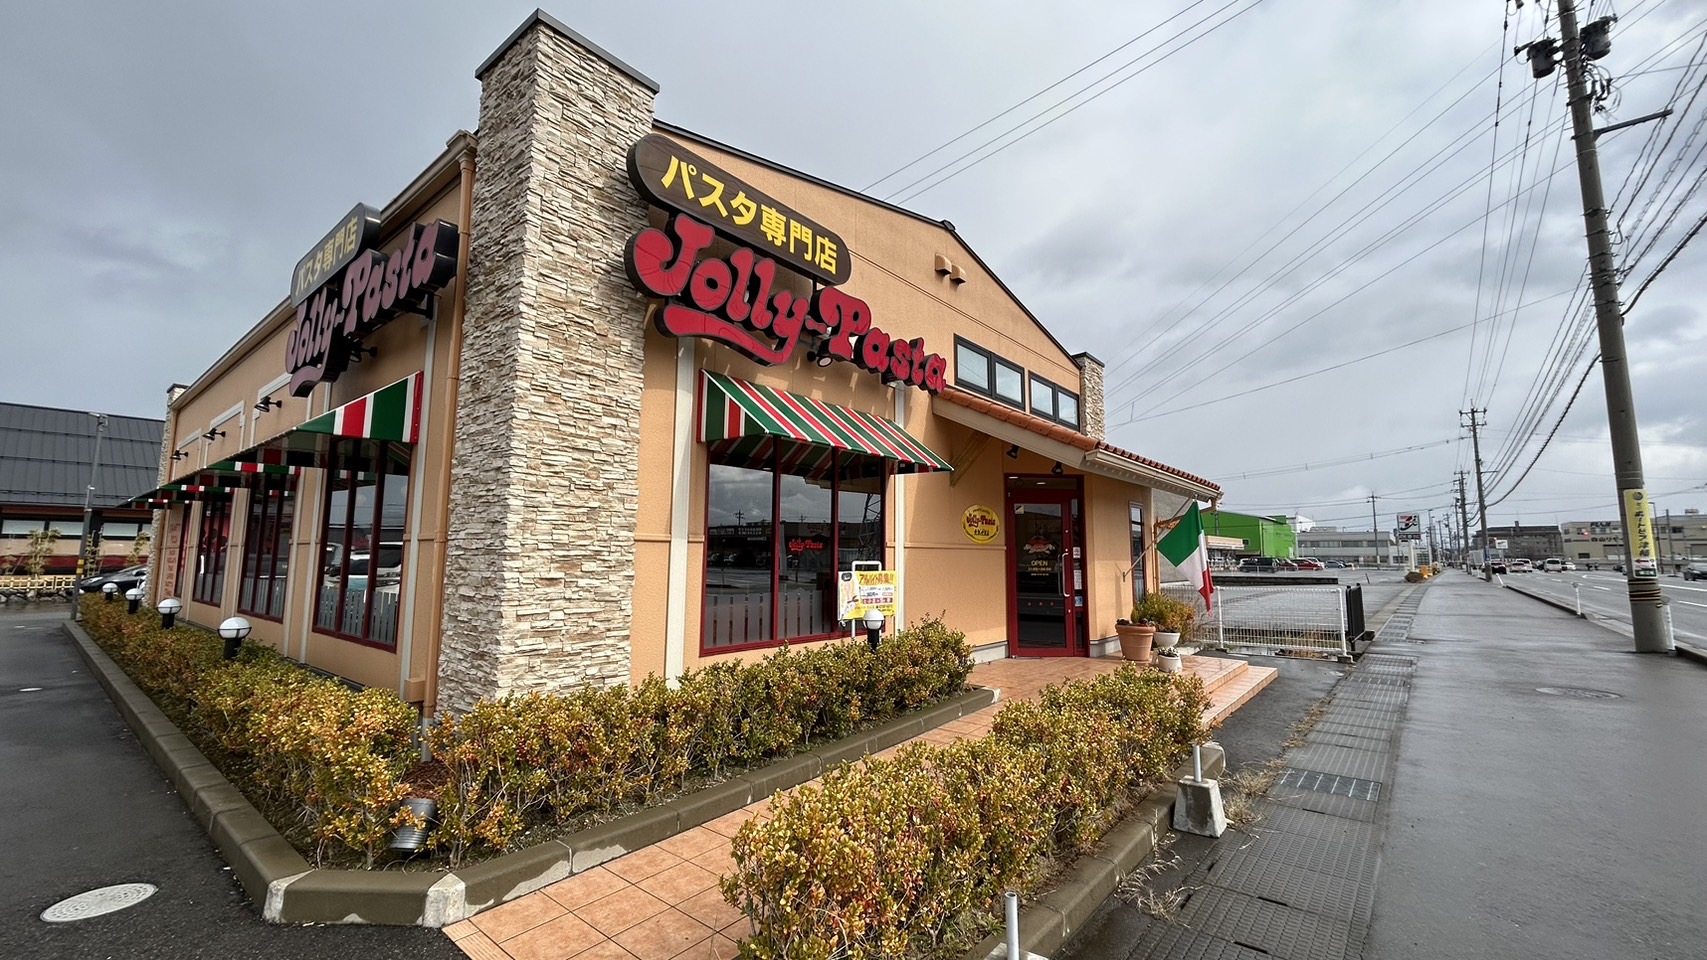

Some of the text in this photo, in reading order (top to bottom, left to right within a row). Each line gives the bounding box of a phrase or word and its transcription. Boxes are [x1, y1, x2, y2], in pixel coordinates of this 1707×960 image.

[295, 215, 358, 296] パスタ専門店
[661, 155, 838, 275] パスタ専門店
[286, 219, 440, 397] Jolly-Pasta
[633, 214, 947, 394] Jolly-Pasta
